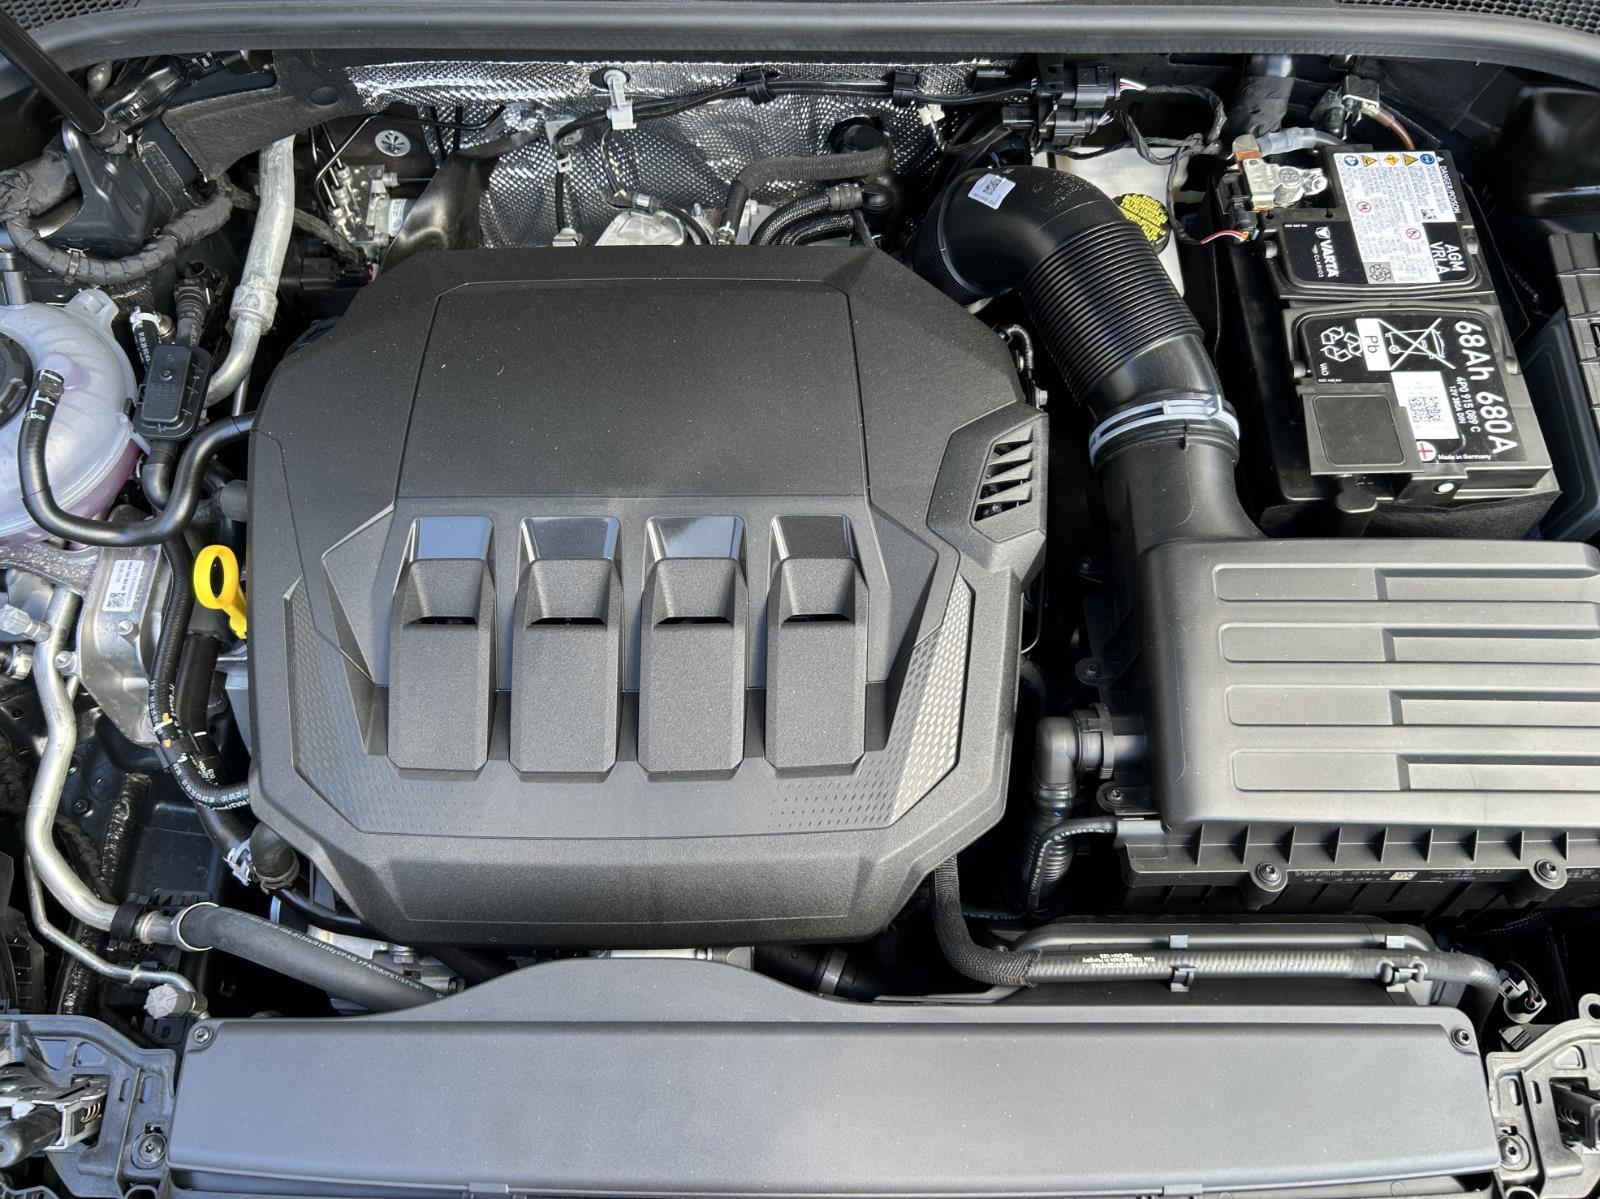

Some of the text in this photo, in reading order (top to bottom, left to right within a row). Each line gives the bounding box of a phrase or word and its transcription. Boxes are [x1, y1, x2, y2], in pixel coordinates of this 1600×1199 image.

[1440, 165, 1461, 213] DANGER/POISON
[1320, 239, 1339, 278] VARTA
[1430, 241, 1451, 274] VRLA
[1444, 244, 1466, 271] AGM
[1364, 335, 1380, 353] Pb
[1449, 385, 1459, 397] 12V
[1458, 411, 1467, 424] DIN
[1454, 320, 1518, 454] 68Ah 680A
[1456, 376, 1482, 433] 4P0 915 089 C
